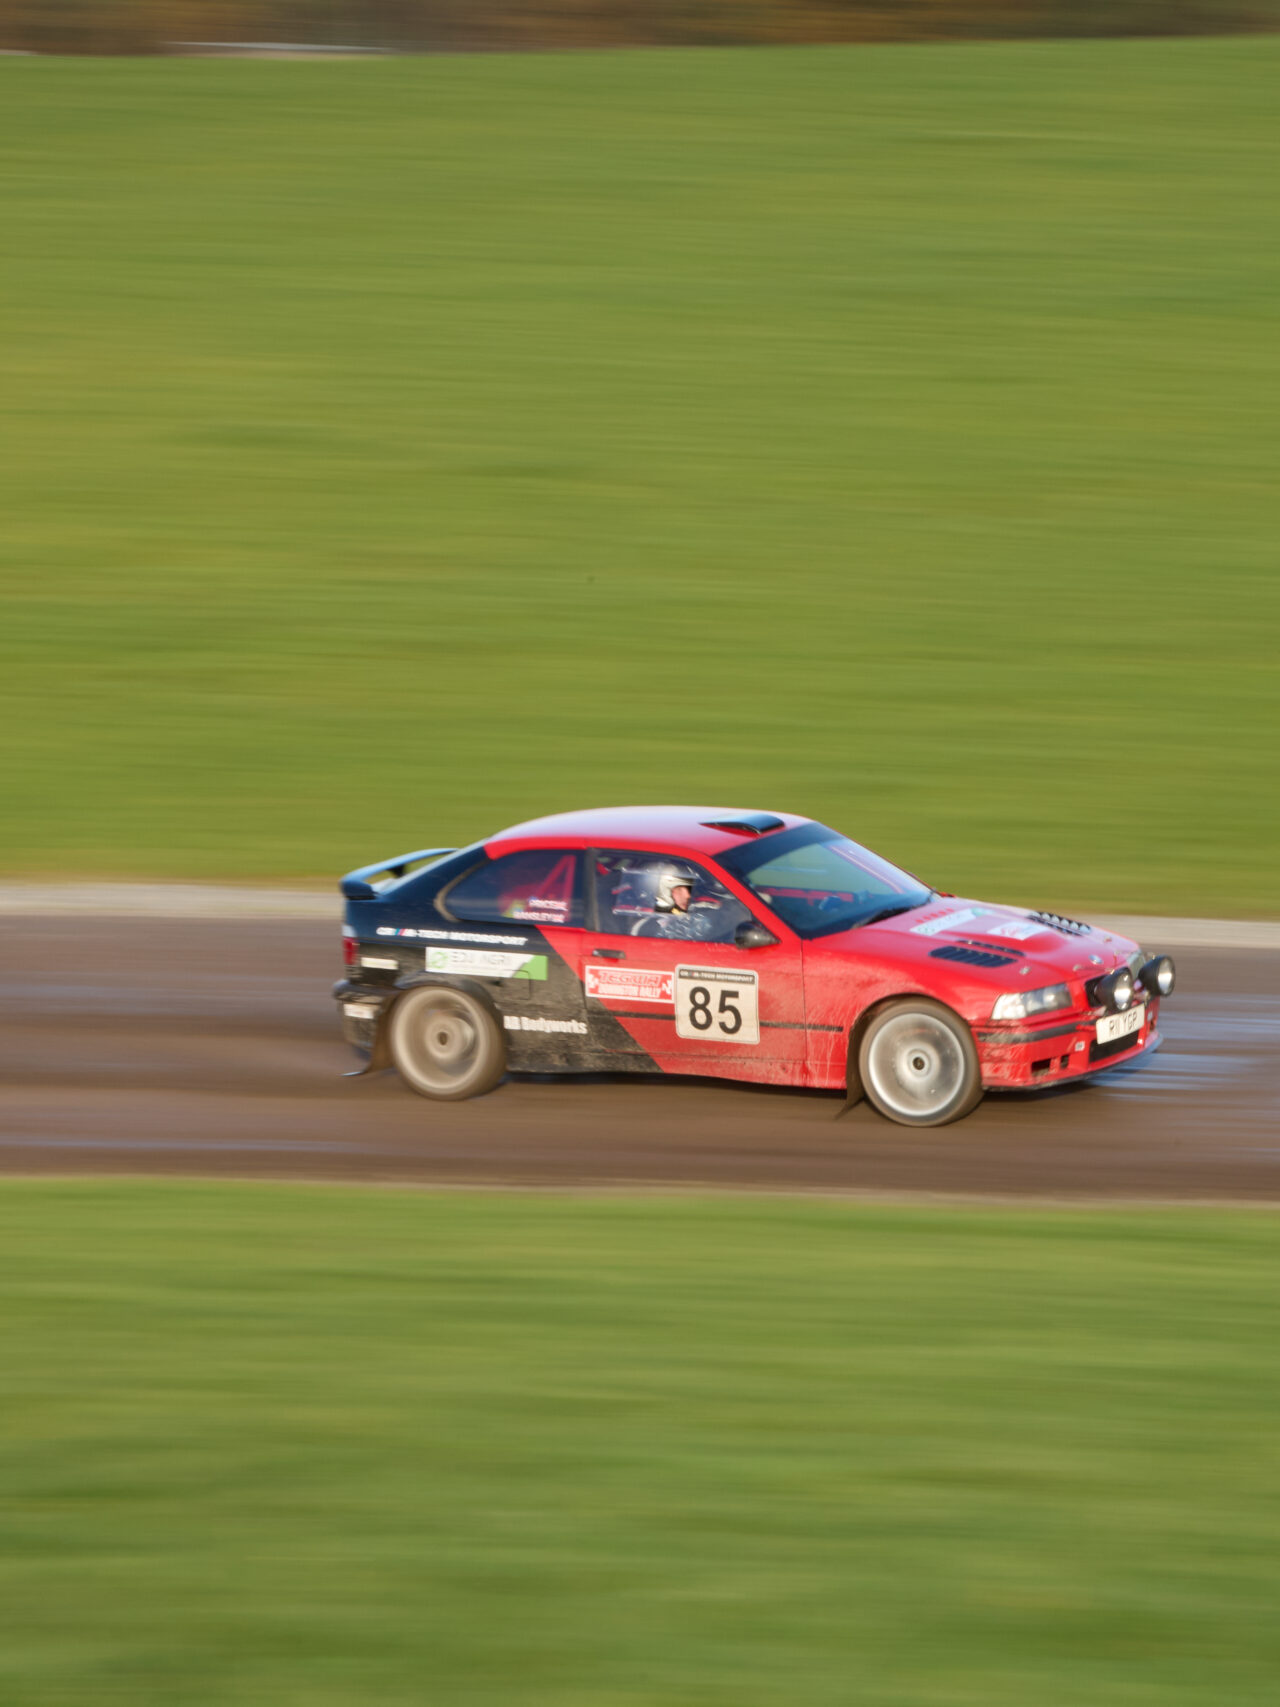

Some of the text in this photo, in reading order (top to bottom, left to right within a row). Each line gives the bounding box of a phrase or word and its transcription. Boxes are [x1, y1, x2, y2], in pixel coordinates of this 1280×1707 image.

[717, 973, 753, 982] MOTORSPORT
[639, 986, 661, 998] RALLY
[689, 986, 742, 1034] 85
[521, 1016, 588, 1035] Bodyworks
[1124, 1011, 1137, 1032] YGP
